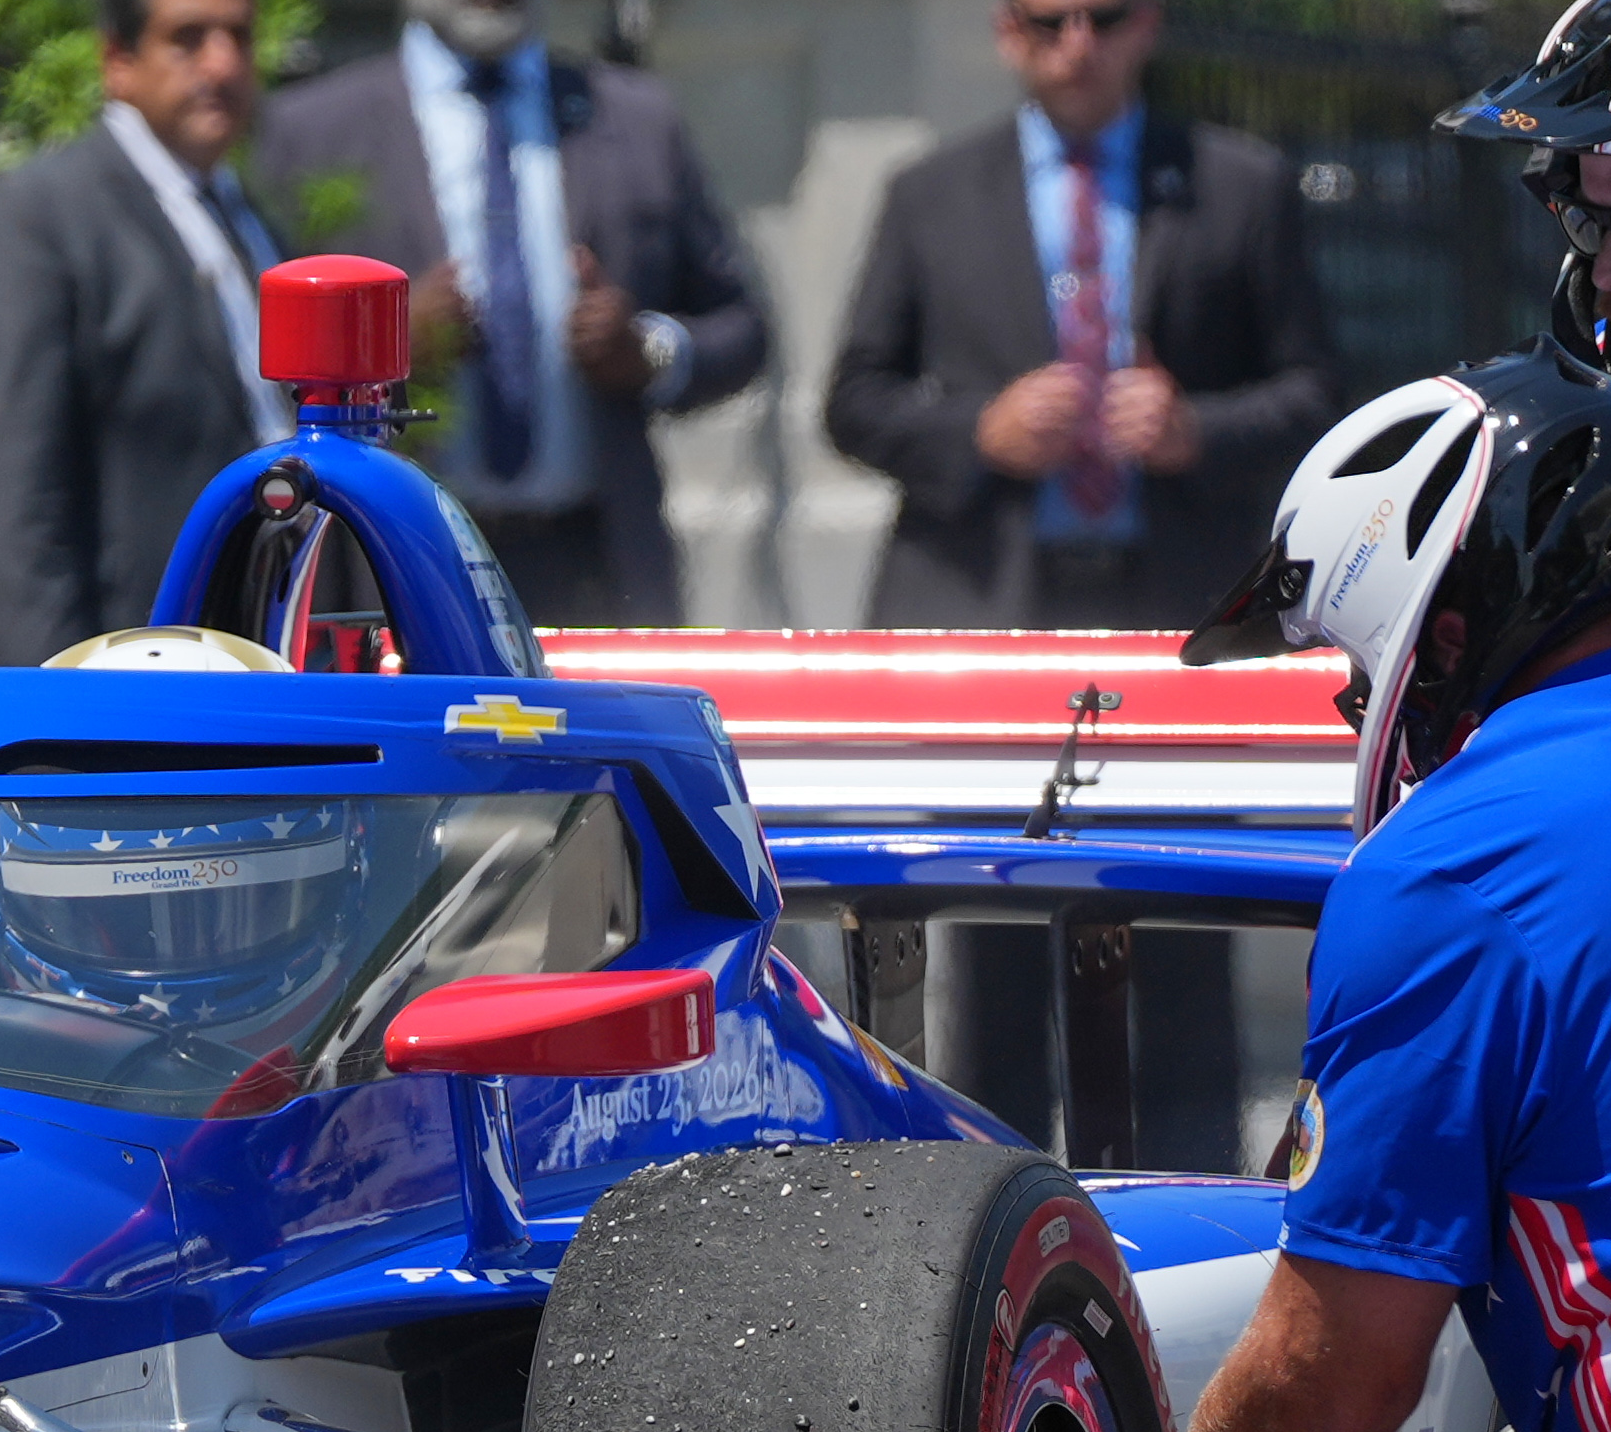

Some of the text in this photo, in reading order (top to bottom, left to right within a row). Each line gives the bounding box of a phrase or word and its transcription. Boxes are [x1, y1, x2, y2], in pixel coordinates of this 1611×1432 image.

[1330, 499, 1394, 611] Freedom 250
[112, 859, 238, 885] Freedom 250
[182, 878, 200, 887] Prix
[570, 1054, 761, 1141] August 23, 2026
